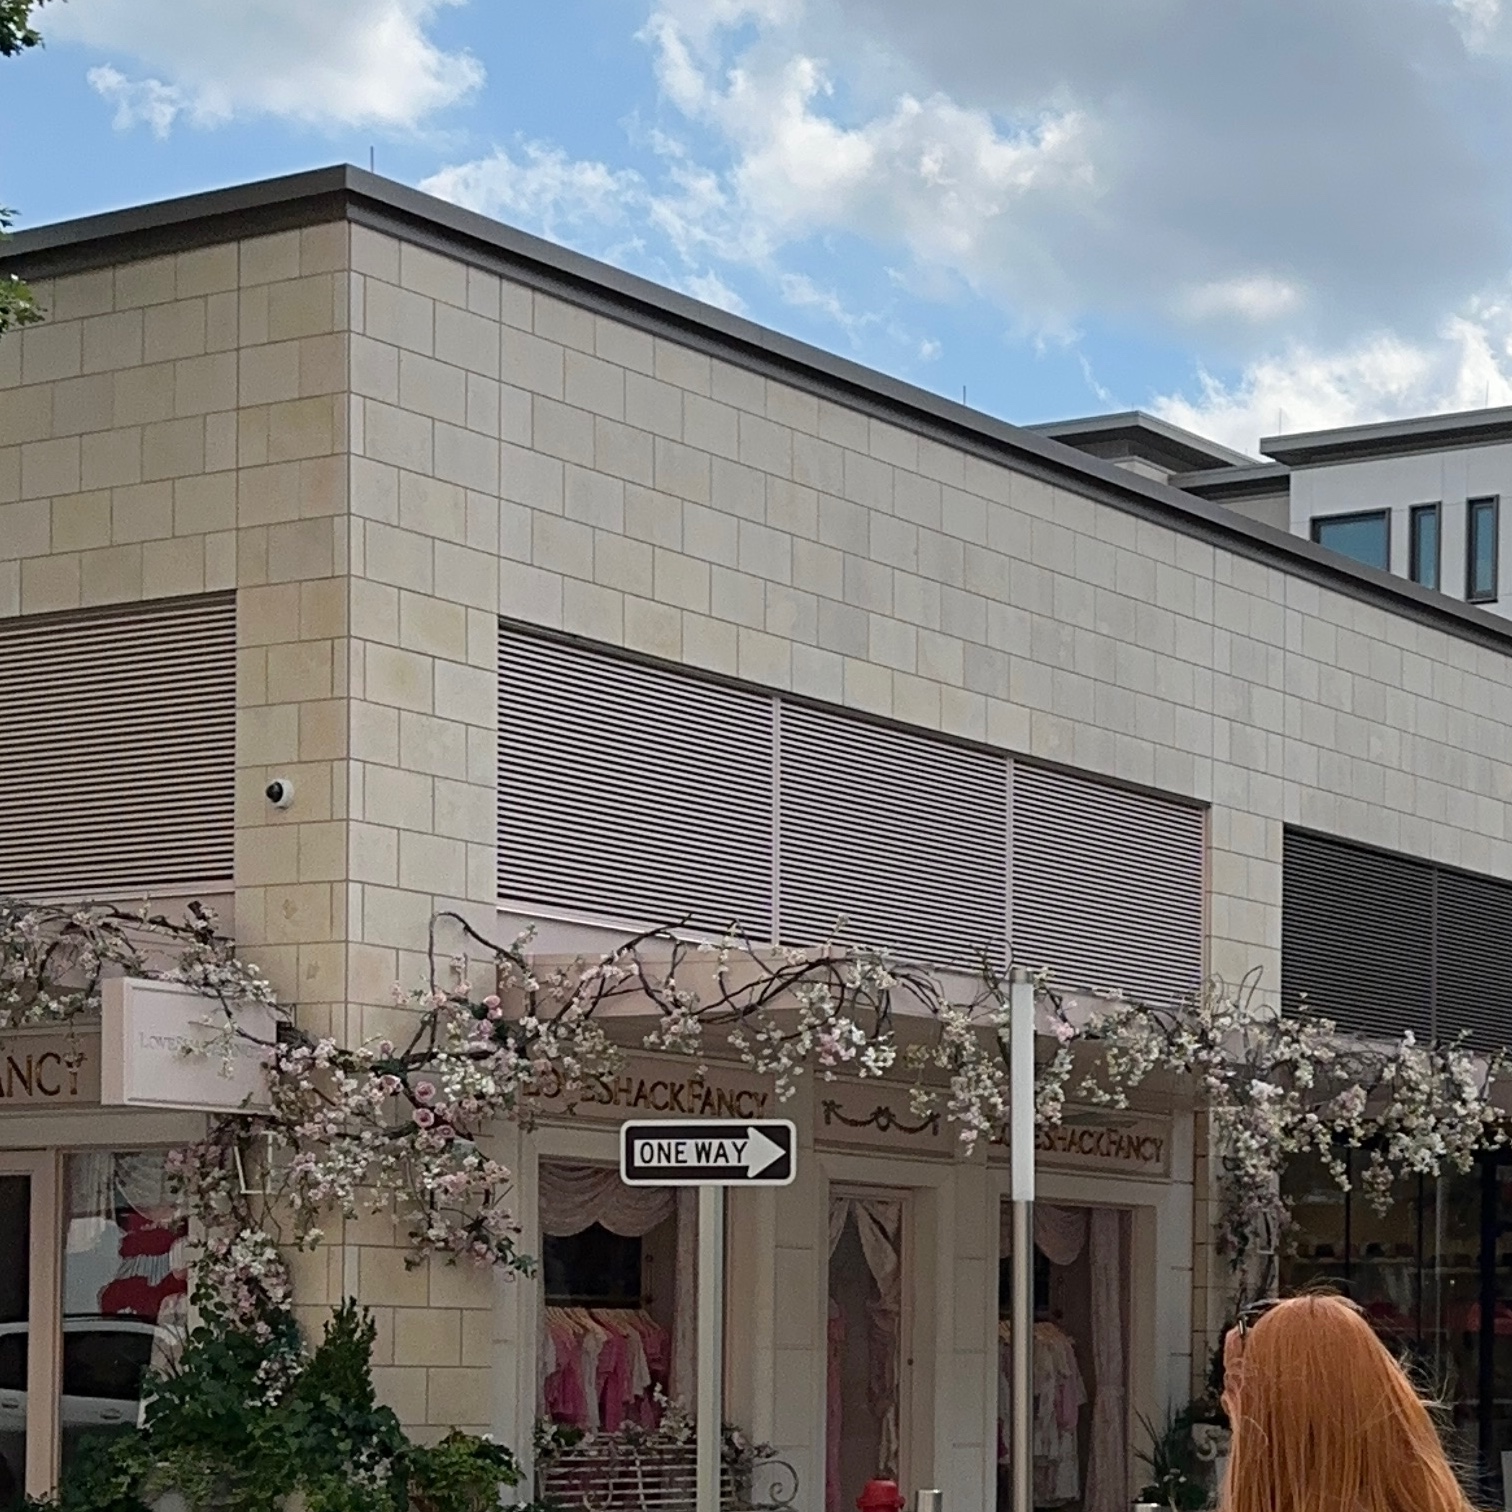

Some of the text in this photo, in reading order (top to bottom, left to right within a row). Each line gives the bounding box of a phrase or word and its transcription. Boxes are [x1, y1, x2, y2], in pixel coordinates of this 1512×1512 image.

[0, 1051, 86, 1097] NCY
[521, 1066, 769, 1119] LOESHACKFANCY
[639, 1141, 748, 1164] ONE WAY
